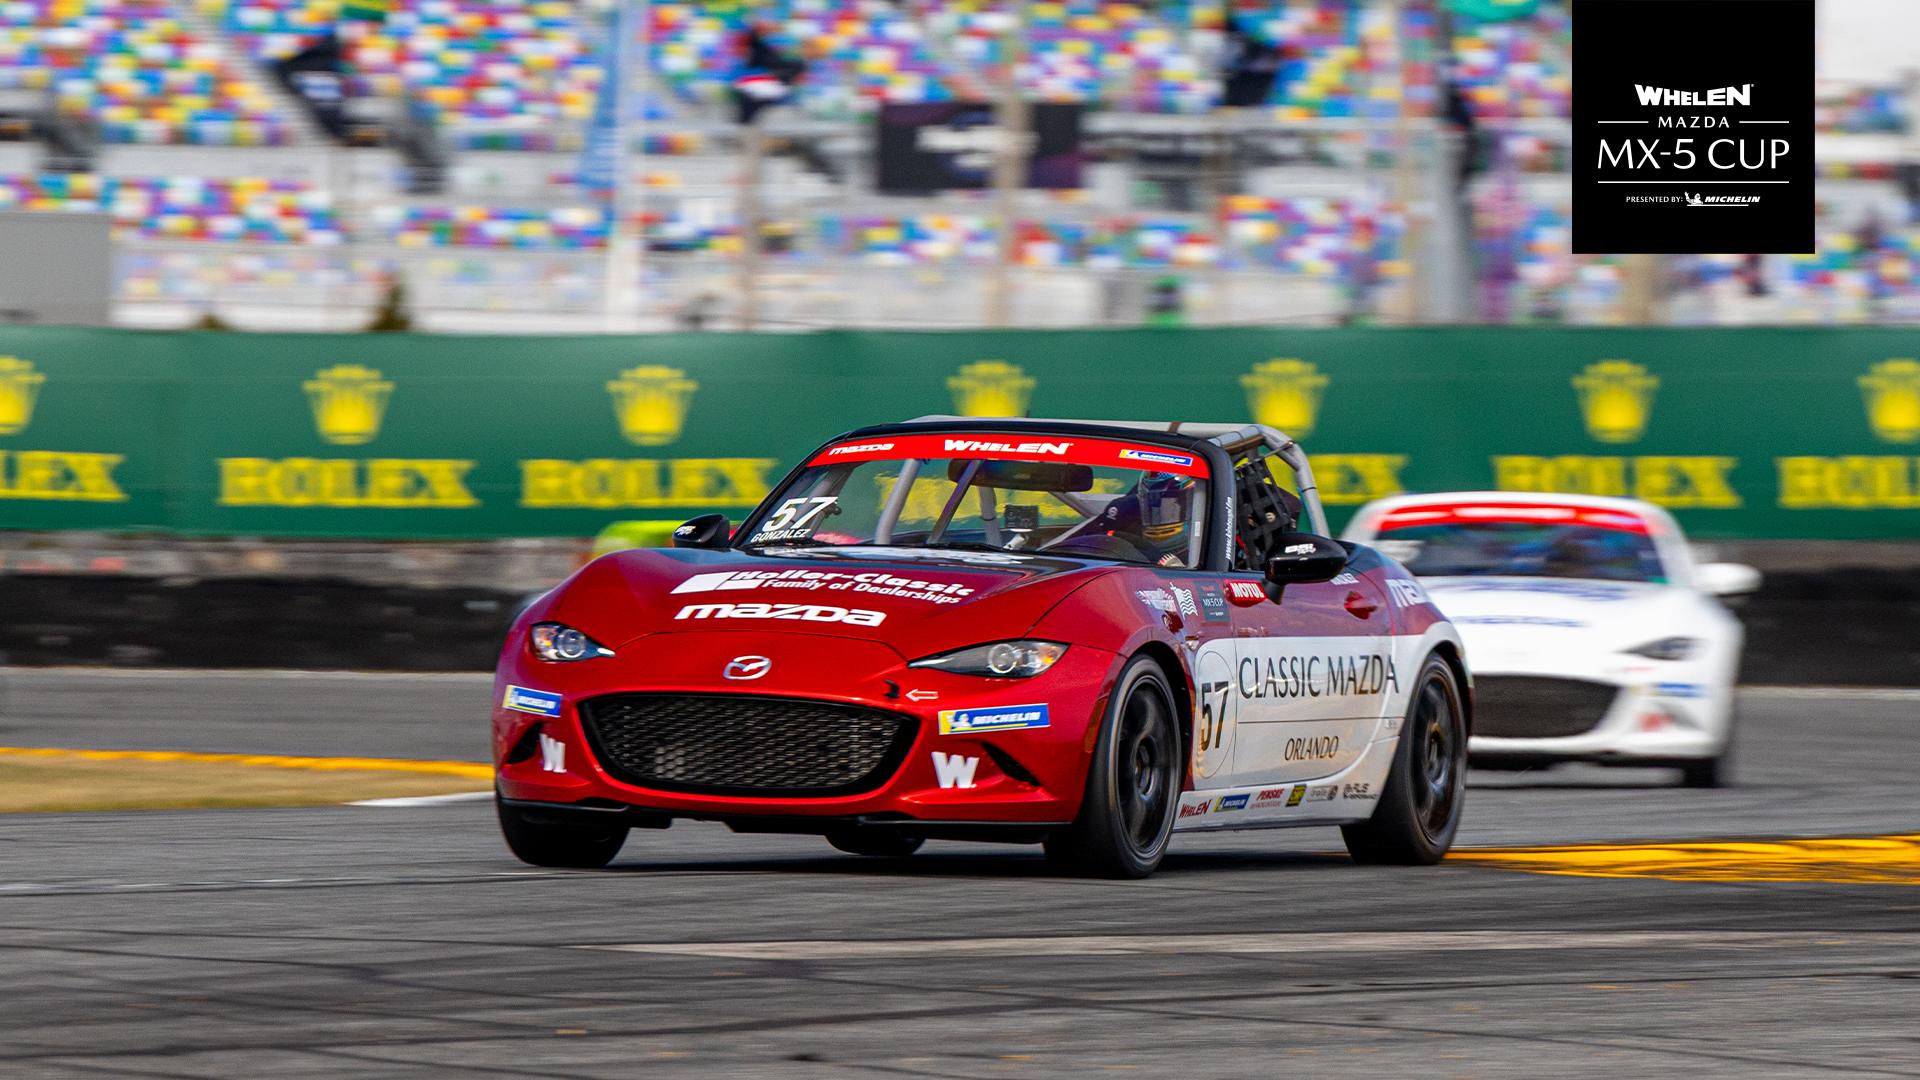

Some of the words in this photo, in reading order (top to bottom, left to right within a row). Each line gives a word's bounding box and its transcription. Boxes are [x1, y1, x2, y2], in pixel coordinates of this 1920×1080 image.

[944, 439, 1070, 455] WHELEN
[216, 457, 477, 506] ROLEX
[1494, 456, 1742, 508] ROLEX
[761, 496, 839, 532] 57
[750, 528, 811, 543] GONZALEZ
[730, 570, 975, 596] Holler-Classic
[761, 579, 827, 590] Family
[828, 581, 856, 590] of
[853, 583, 962, 604] Dealerships
[1229, 582, 1266, 599] MOTUL
[1238, 656, 1321, 699] CLASSIC
[1326, 654, 1399, 696] MAZDA
[972, 712, 1041, 725] MICHELIN
[1201, 681, 1229, 752] 57
[1284, 736, 1340, 761] ORLANDO
